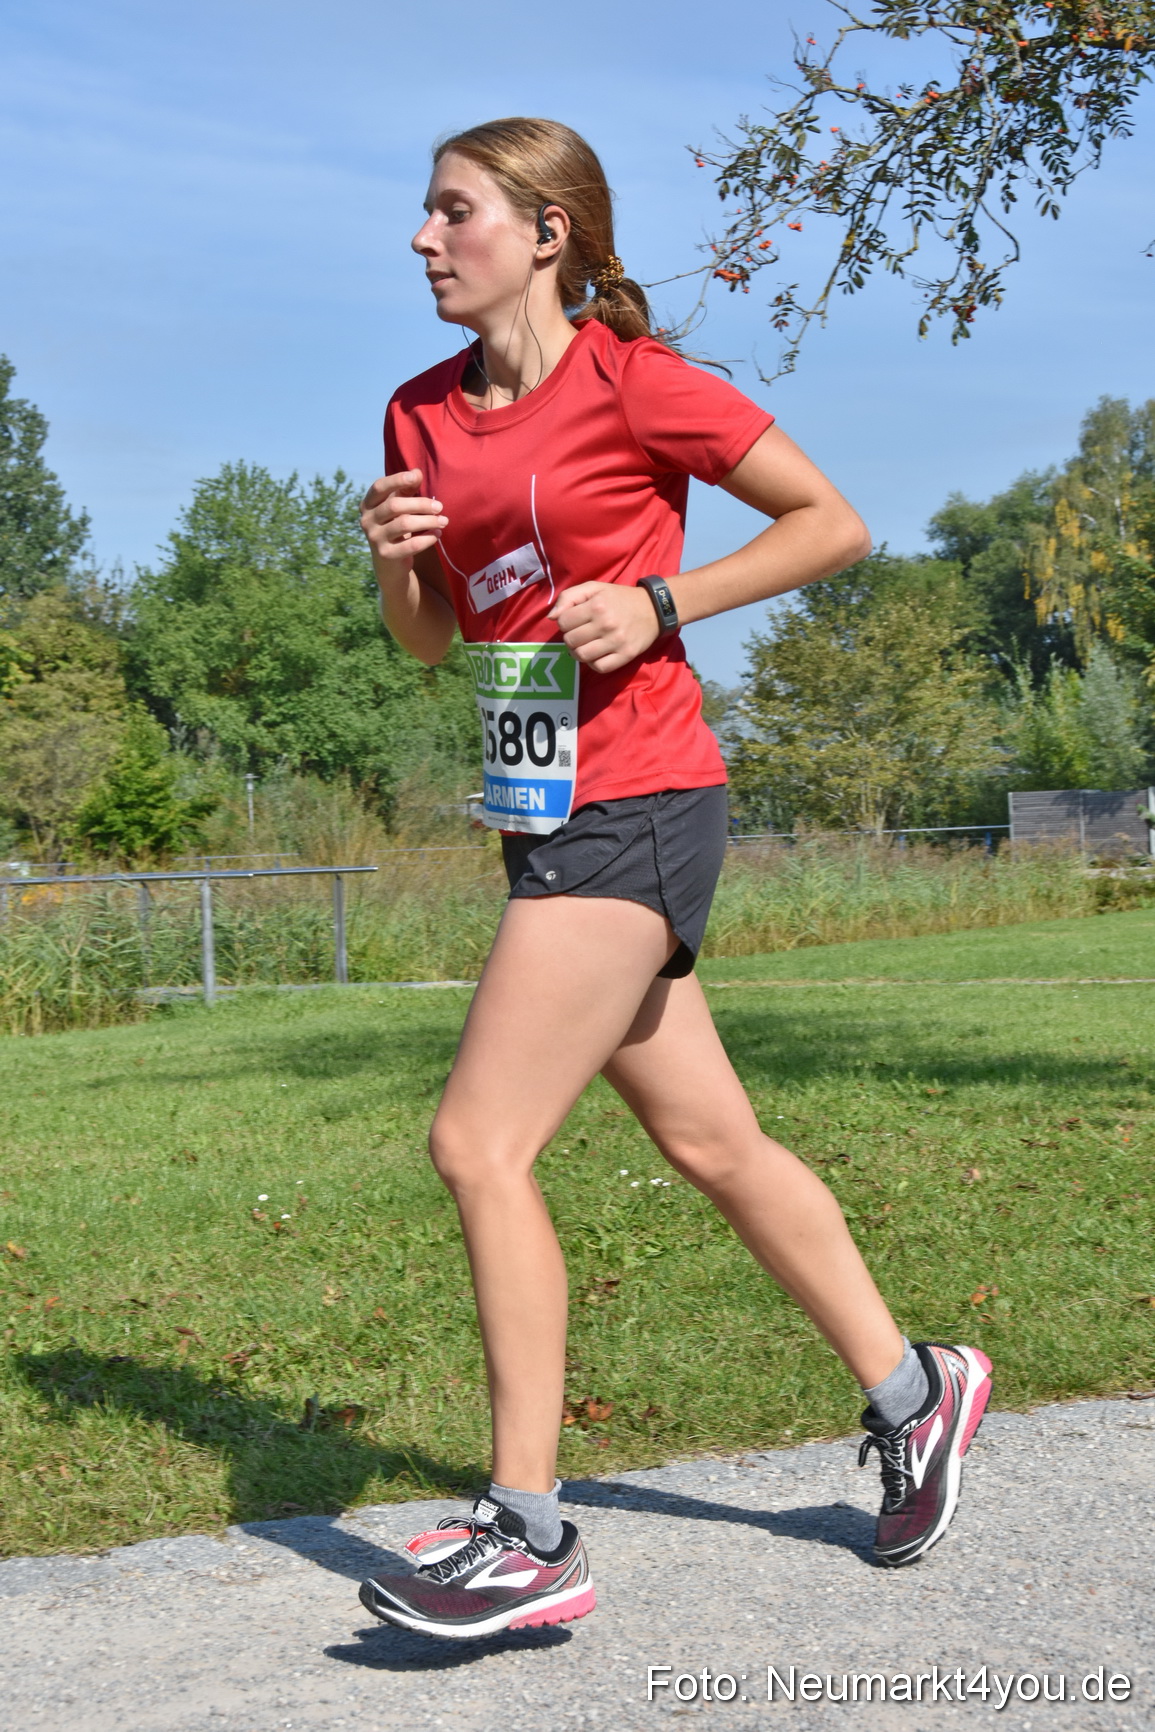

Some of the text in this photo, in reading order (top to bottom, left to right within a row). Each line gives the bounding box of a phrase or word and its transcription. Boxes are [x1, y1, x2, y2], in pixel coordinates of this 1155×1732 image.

[487, 565, 517, 594] DEHN
[481, 707, 556, 767] 580
[485, 783, 545, 810] ARMEN
[526, 1553, 548, 1567] BROOKS
